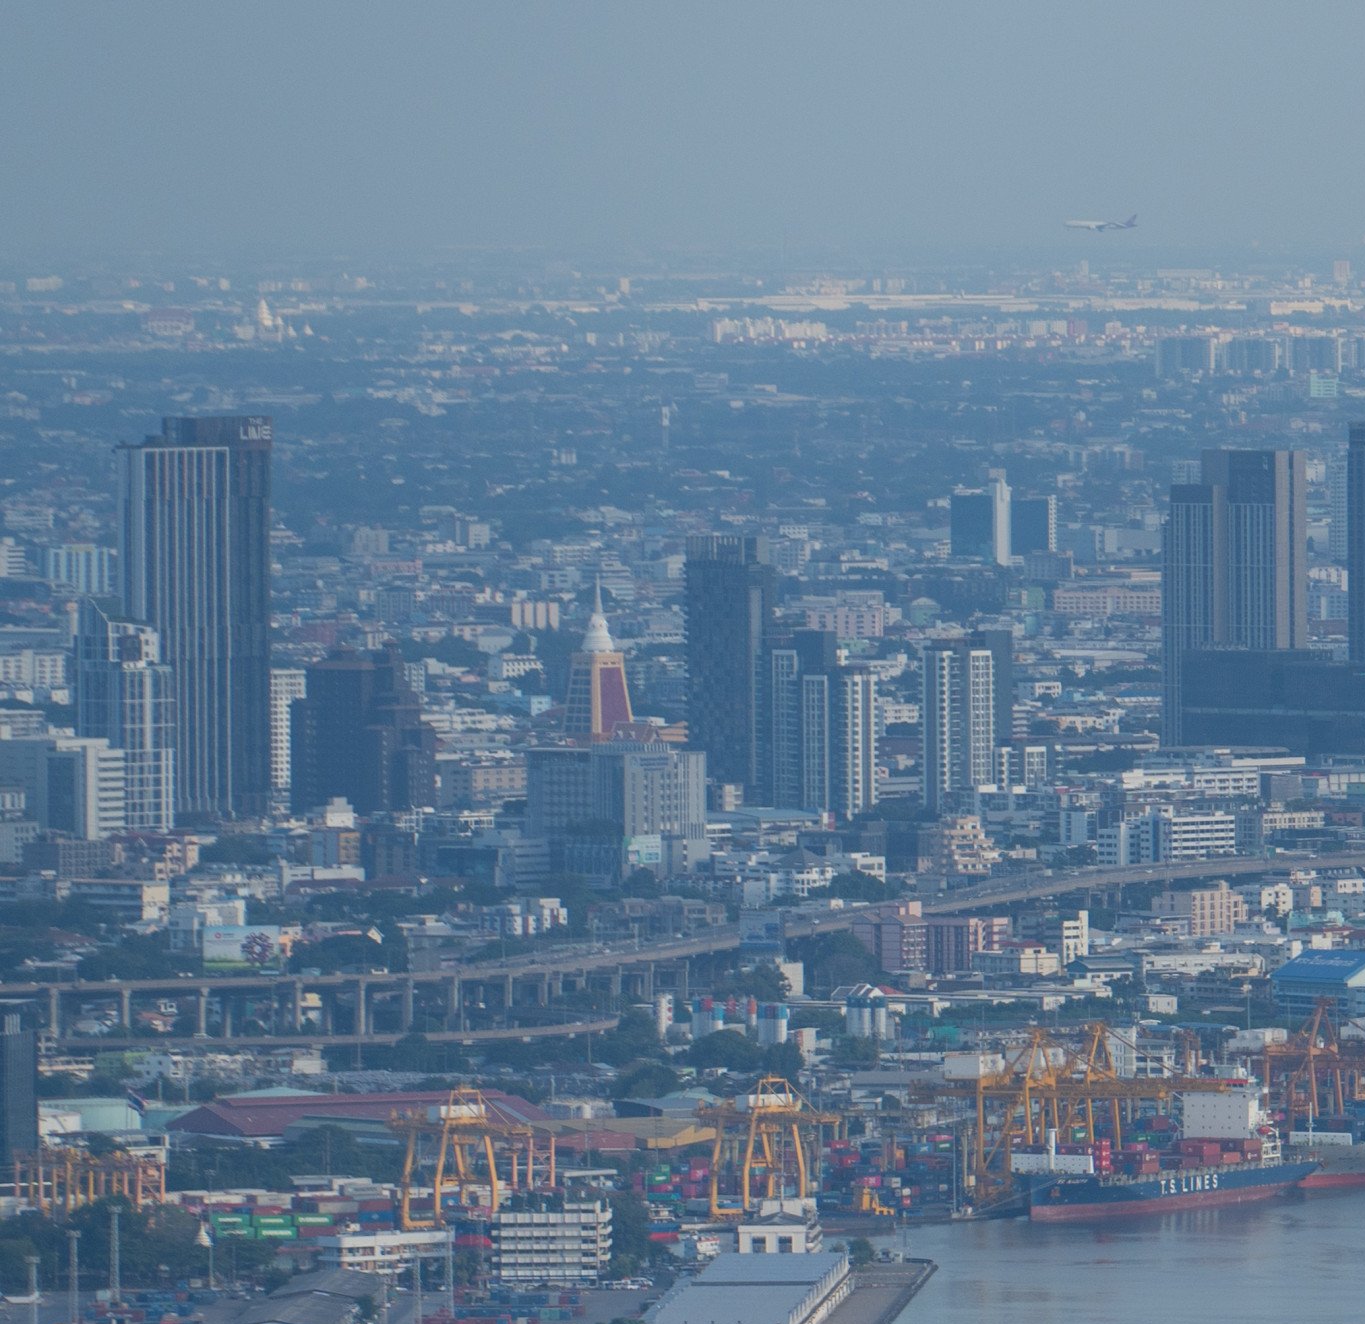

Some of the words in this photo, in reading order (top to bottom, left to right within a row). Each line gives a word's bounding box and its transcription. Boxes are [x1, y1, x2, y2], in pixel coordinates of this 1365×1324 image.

[248, 416, 263, 424] THE
[240, 426, 272, 440] LINE
[1160, 1180, 1177, 1195] T.S.
[1182, 1174, 1218, 1192] LINES
